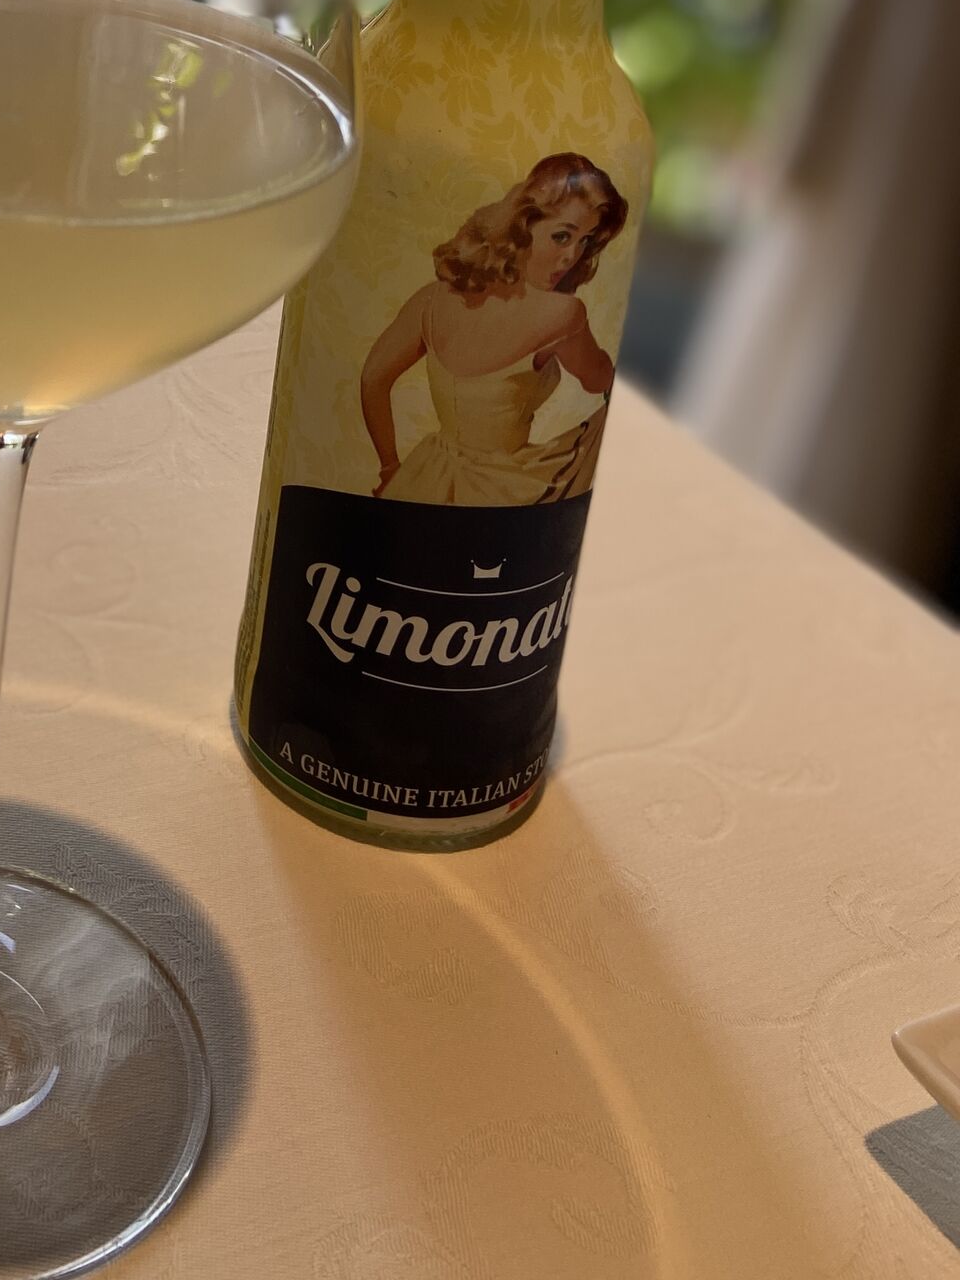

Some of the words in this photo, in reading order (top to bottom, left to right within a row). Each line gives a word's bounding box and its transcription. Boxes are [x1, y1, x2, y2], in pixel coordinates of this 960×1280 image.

[278, 741, 295, 765] A
[300, 753, 420, 807] GENUINE
[427, 771, 522, 808] ITALIAN
